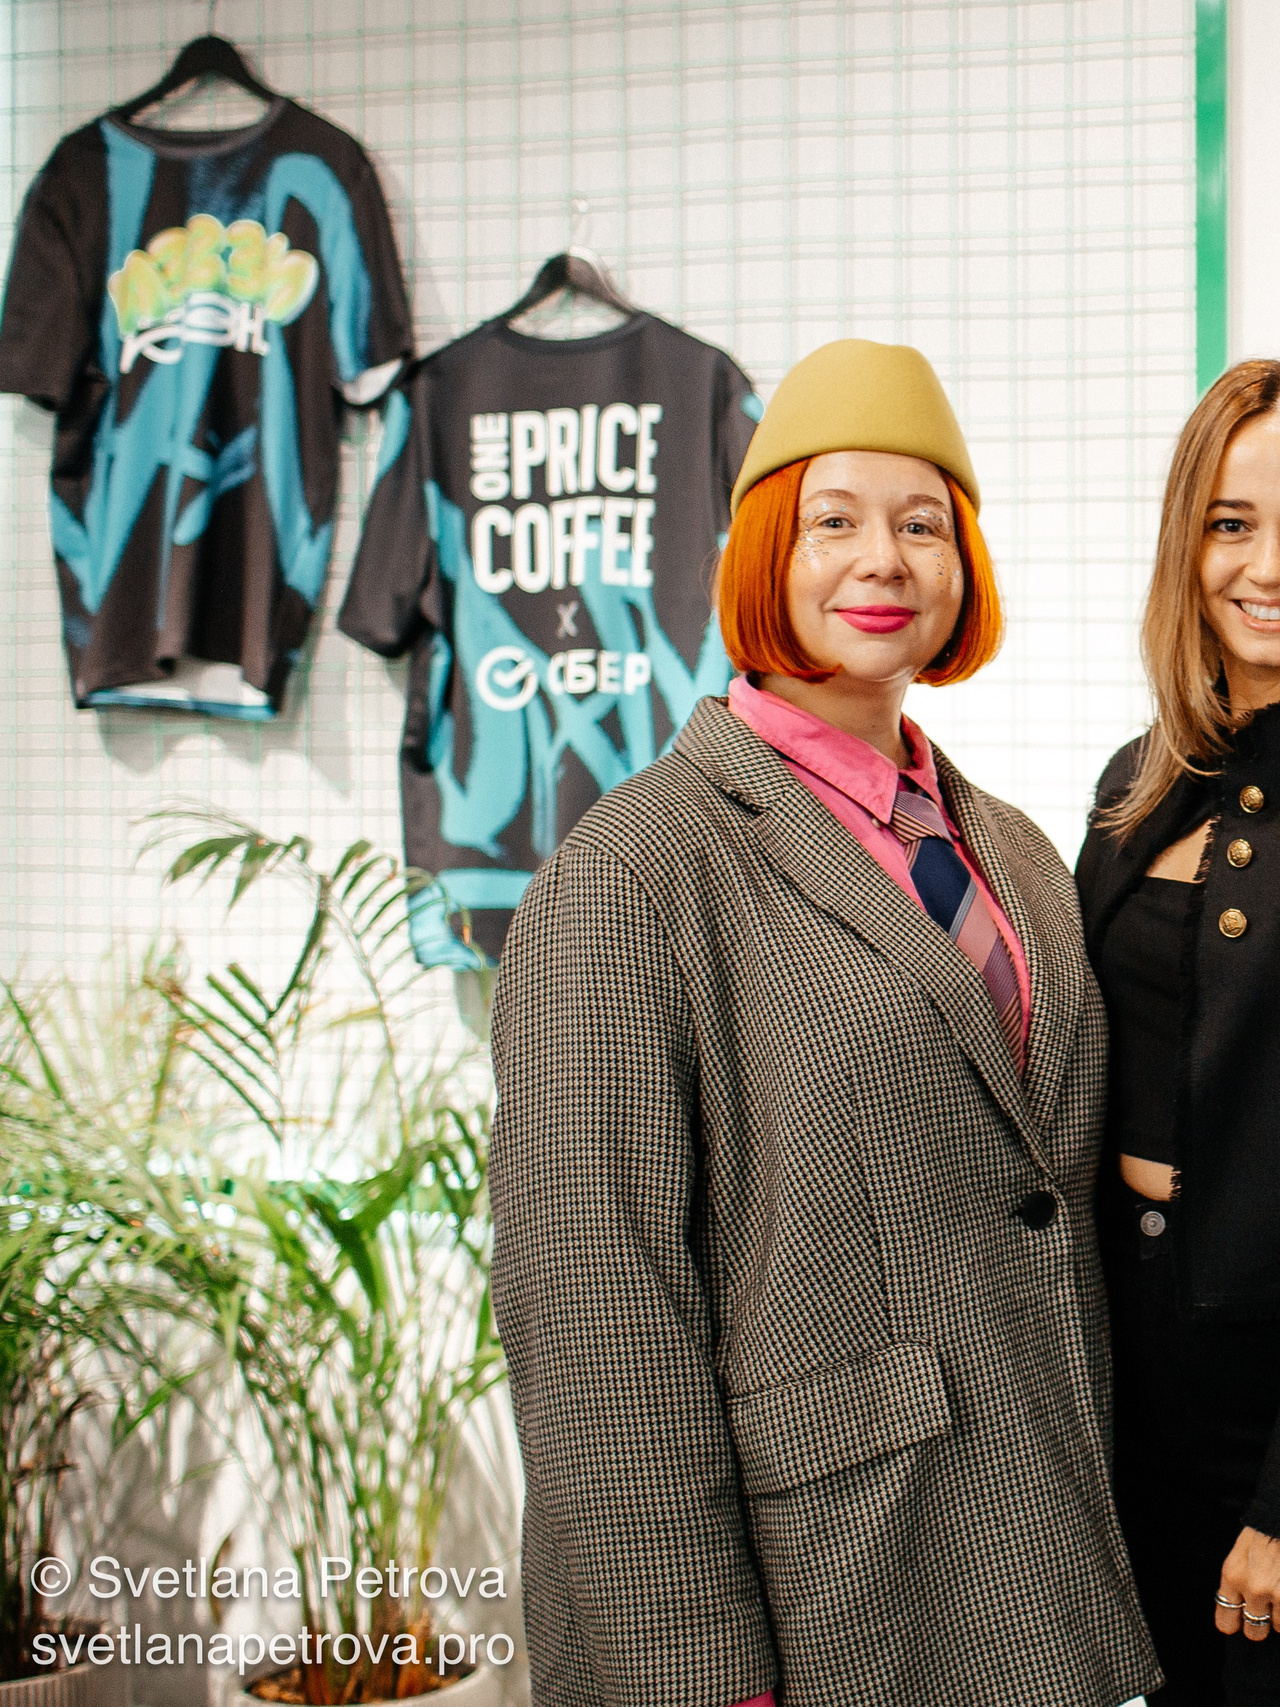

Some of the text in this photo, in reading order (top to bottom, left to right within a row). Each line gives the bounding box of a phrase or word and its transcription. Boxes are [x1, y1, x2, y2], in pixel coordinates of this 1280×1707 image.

[471, 403, 663, 500] ONE PRICE
[473, 496, 656, 593] COFFEE
[547, 649, 653, 695] СБЕР
